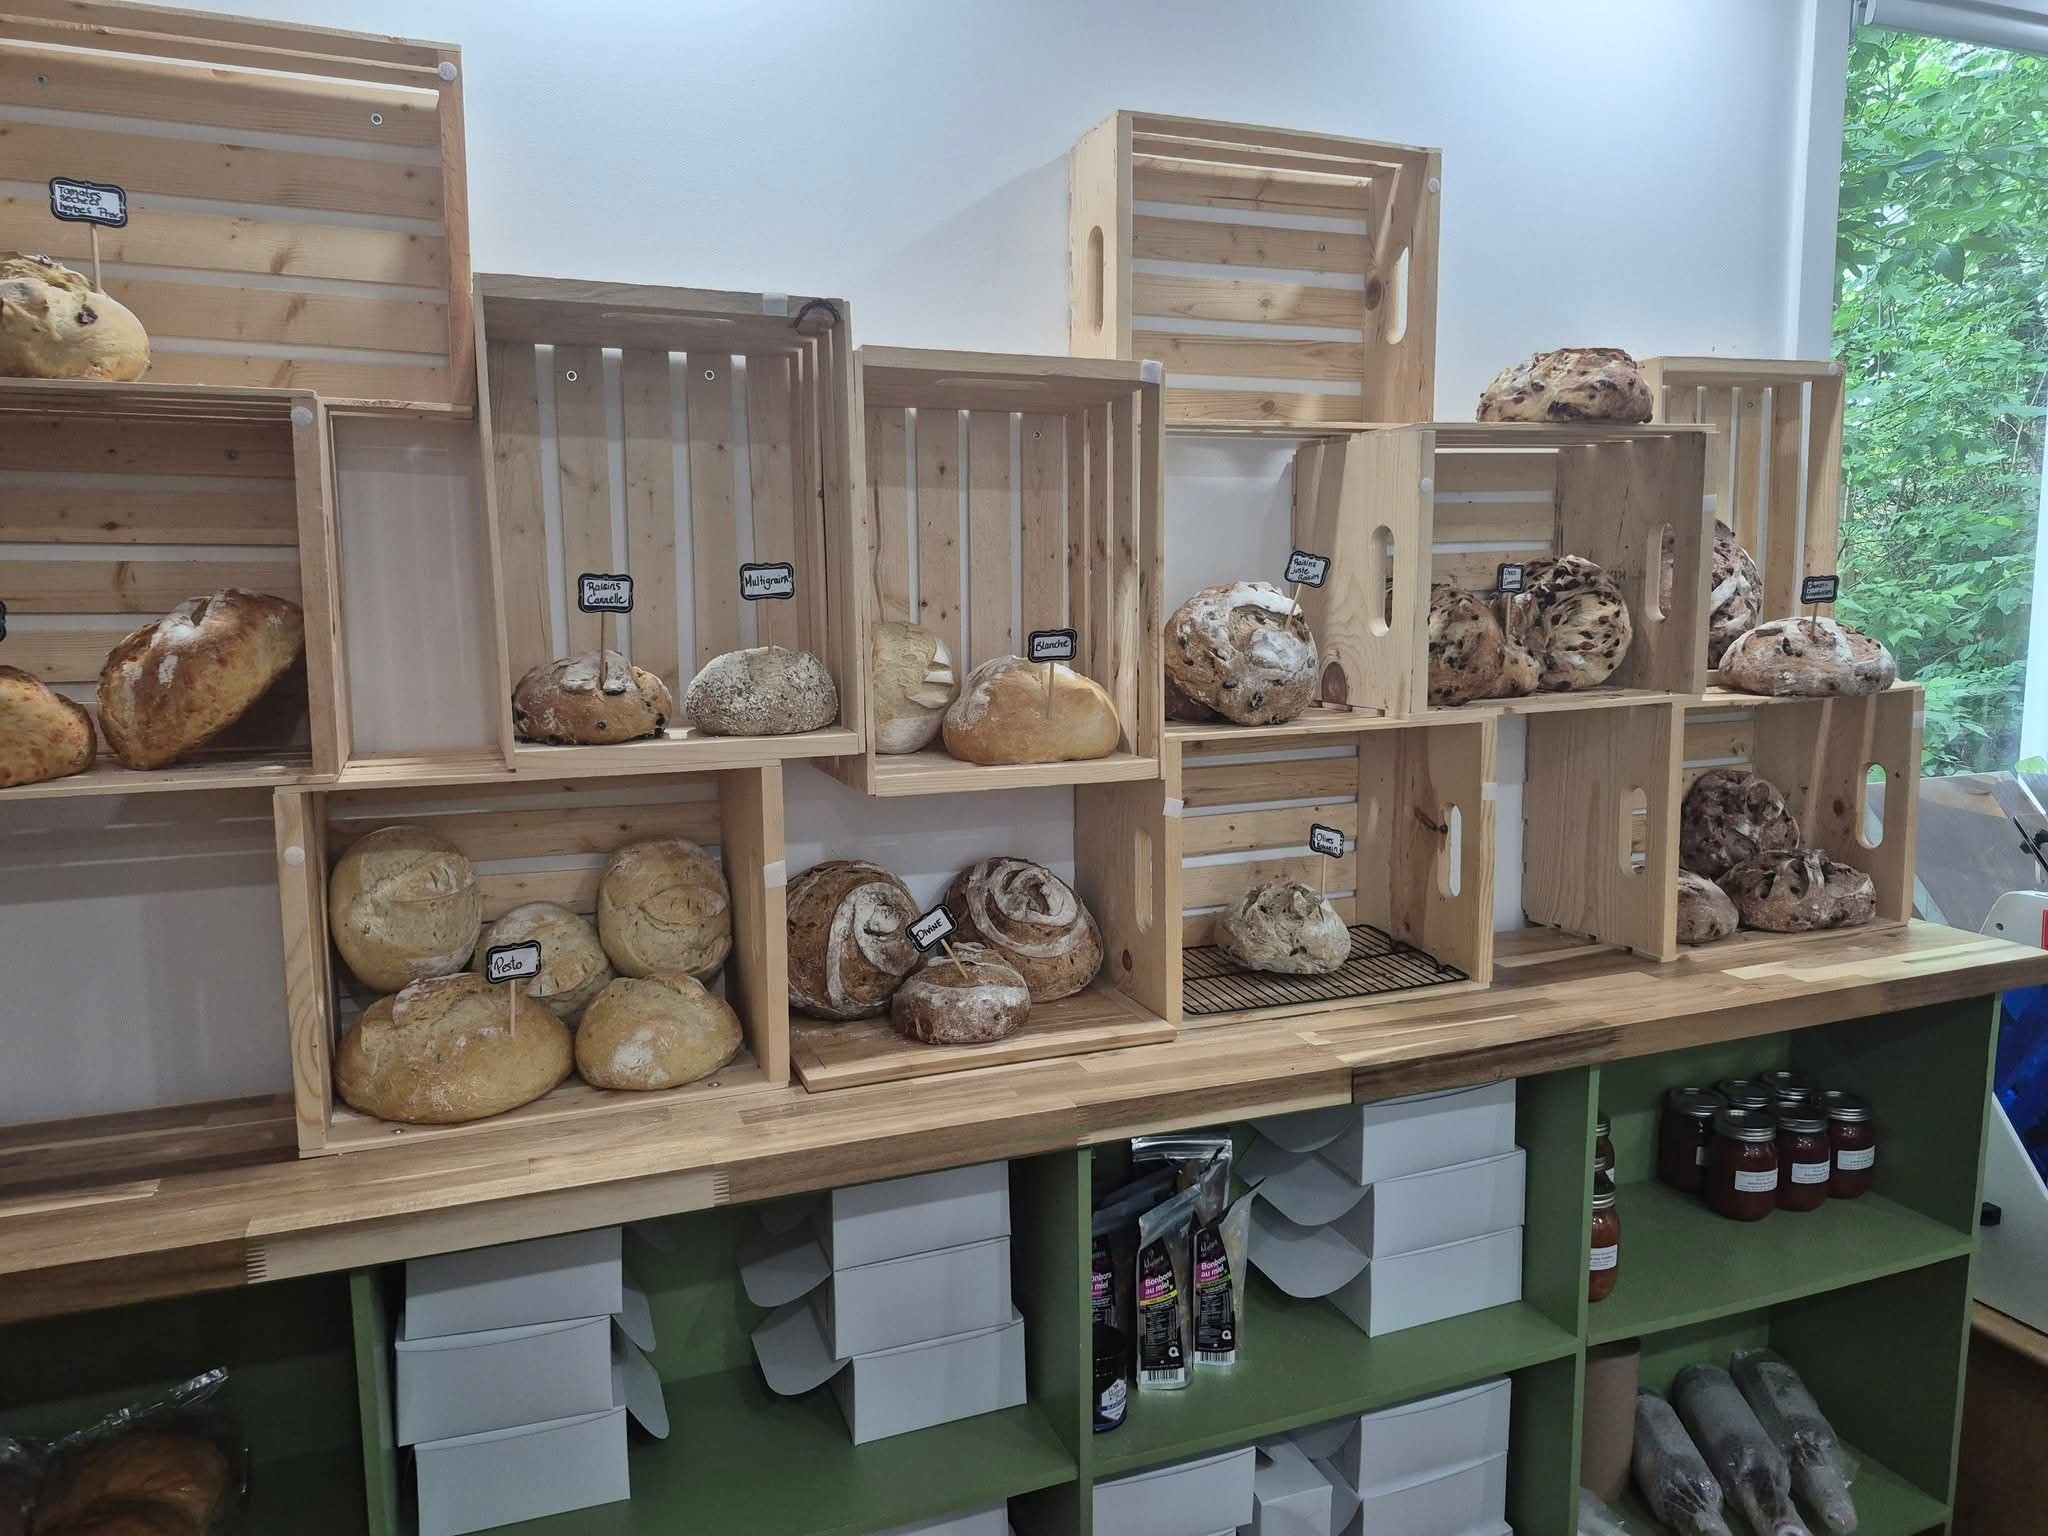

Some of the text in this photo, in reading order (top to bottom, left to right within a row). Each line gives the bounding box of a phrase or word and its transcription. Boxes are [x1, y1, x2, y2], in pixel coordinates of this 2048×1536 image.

[586, 581, 621, 596] Raisins
[1035, 640, 1070, 652] Blanche
[493, 956, 523, 975] Pesto
[1201, 1255, 1227, 1271] Bonbons
[1211, 1263, 1225, 1276] miel
[1092, 1271, 1112, 1283] onbons
[1145, 1269, 1173, 1288] Bonbons
[1145, 1279, 1170, 1296] au miel
